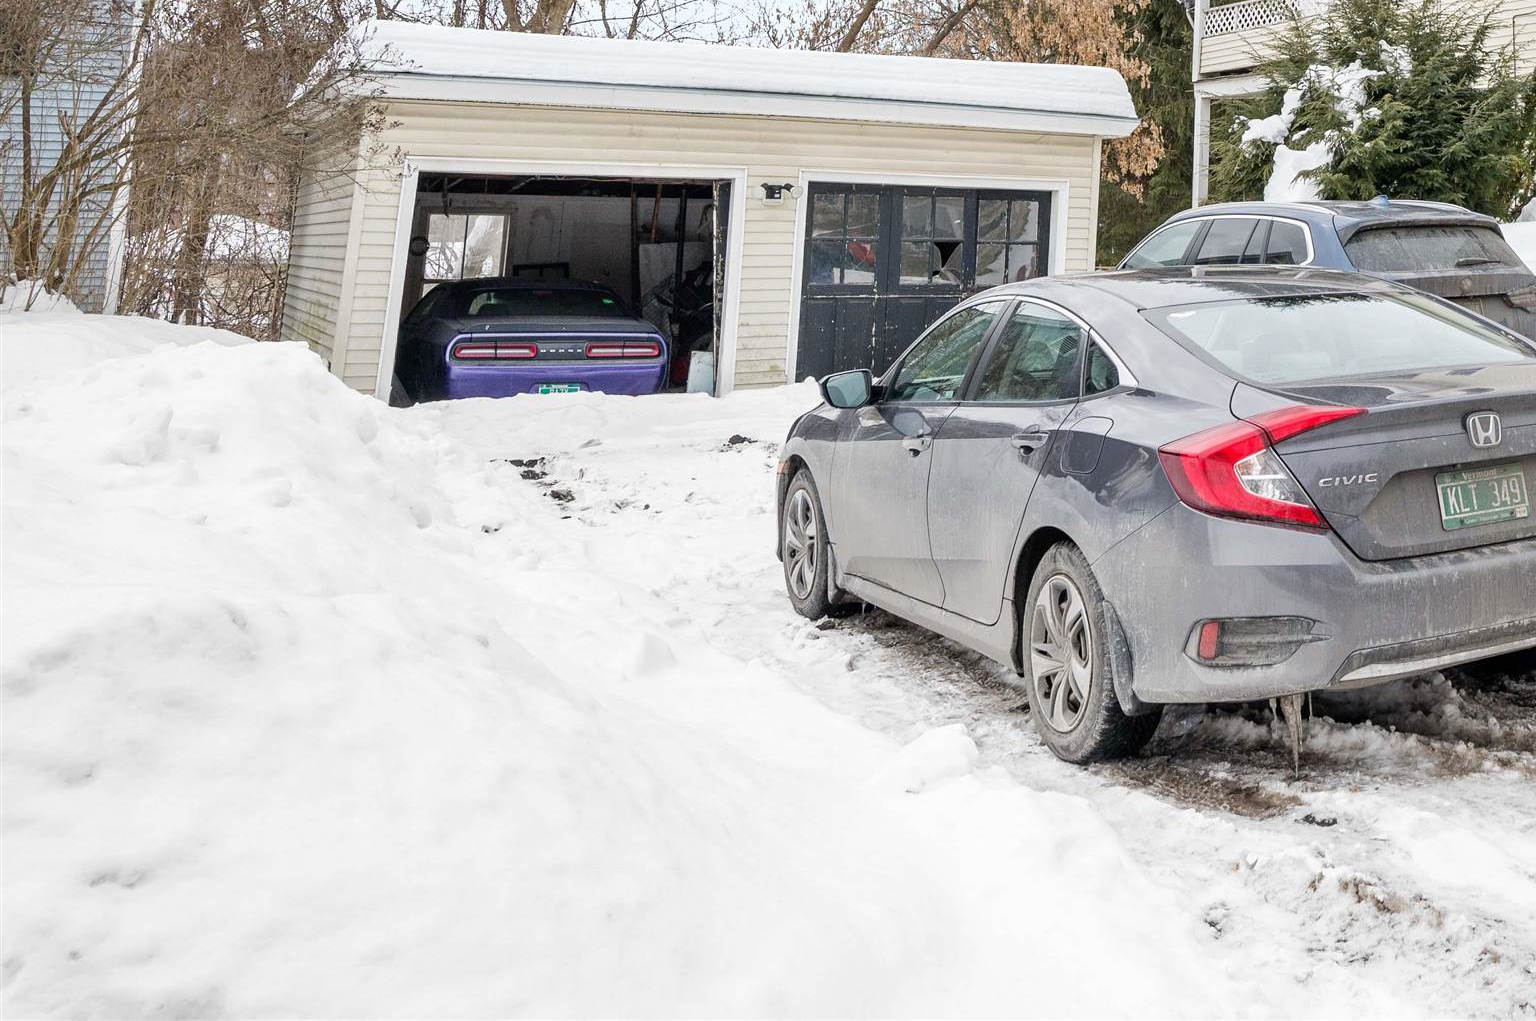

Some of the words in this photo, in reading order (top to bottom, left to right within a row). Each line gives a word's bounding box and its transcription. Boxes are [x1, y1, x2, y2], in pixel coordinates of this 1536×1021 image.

[1318, 473, 1378, 486] CIVIC
[1462, 468, 1497, 481] Vermont
[1447, 483, 1478, 515] KLT
[1488, 477, 1521, 507] 349
